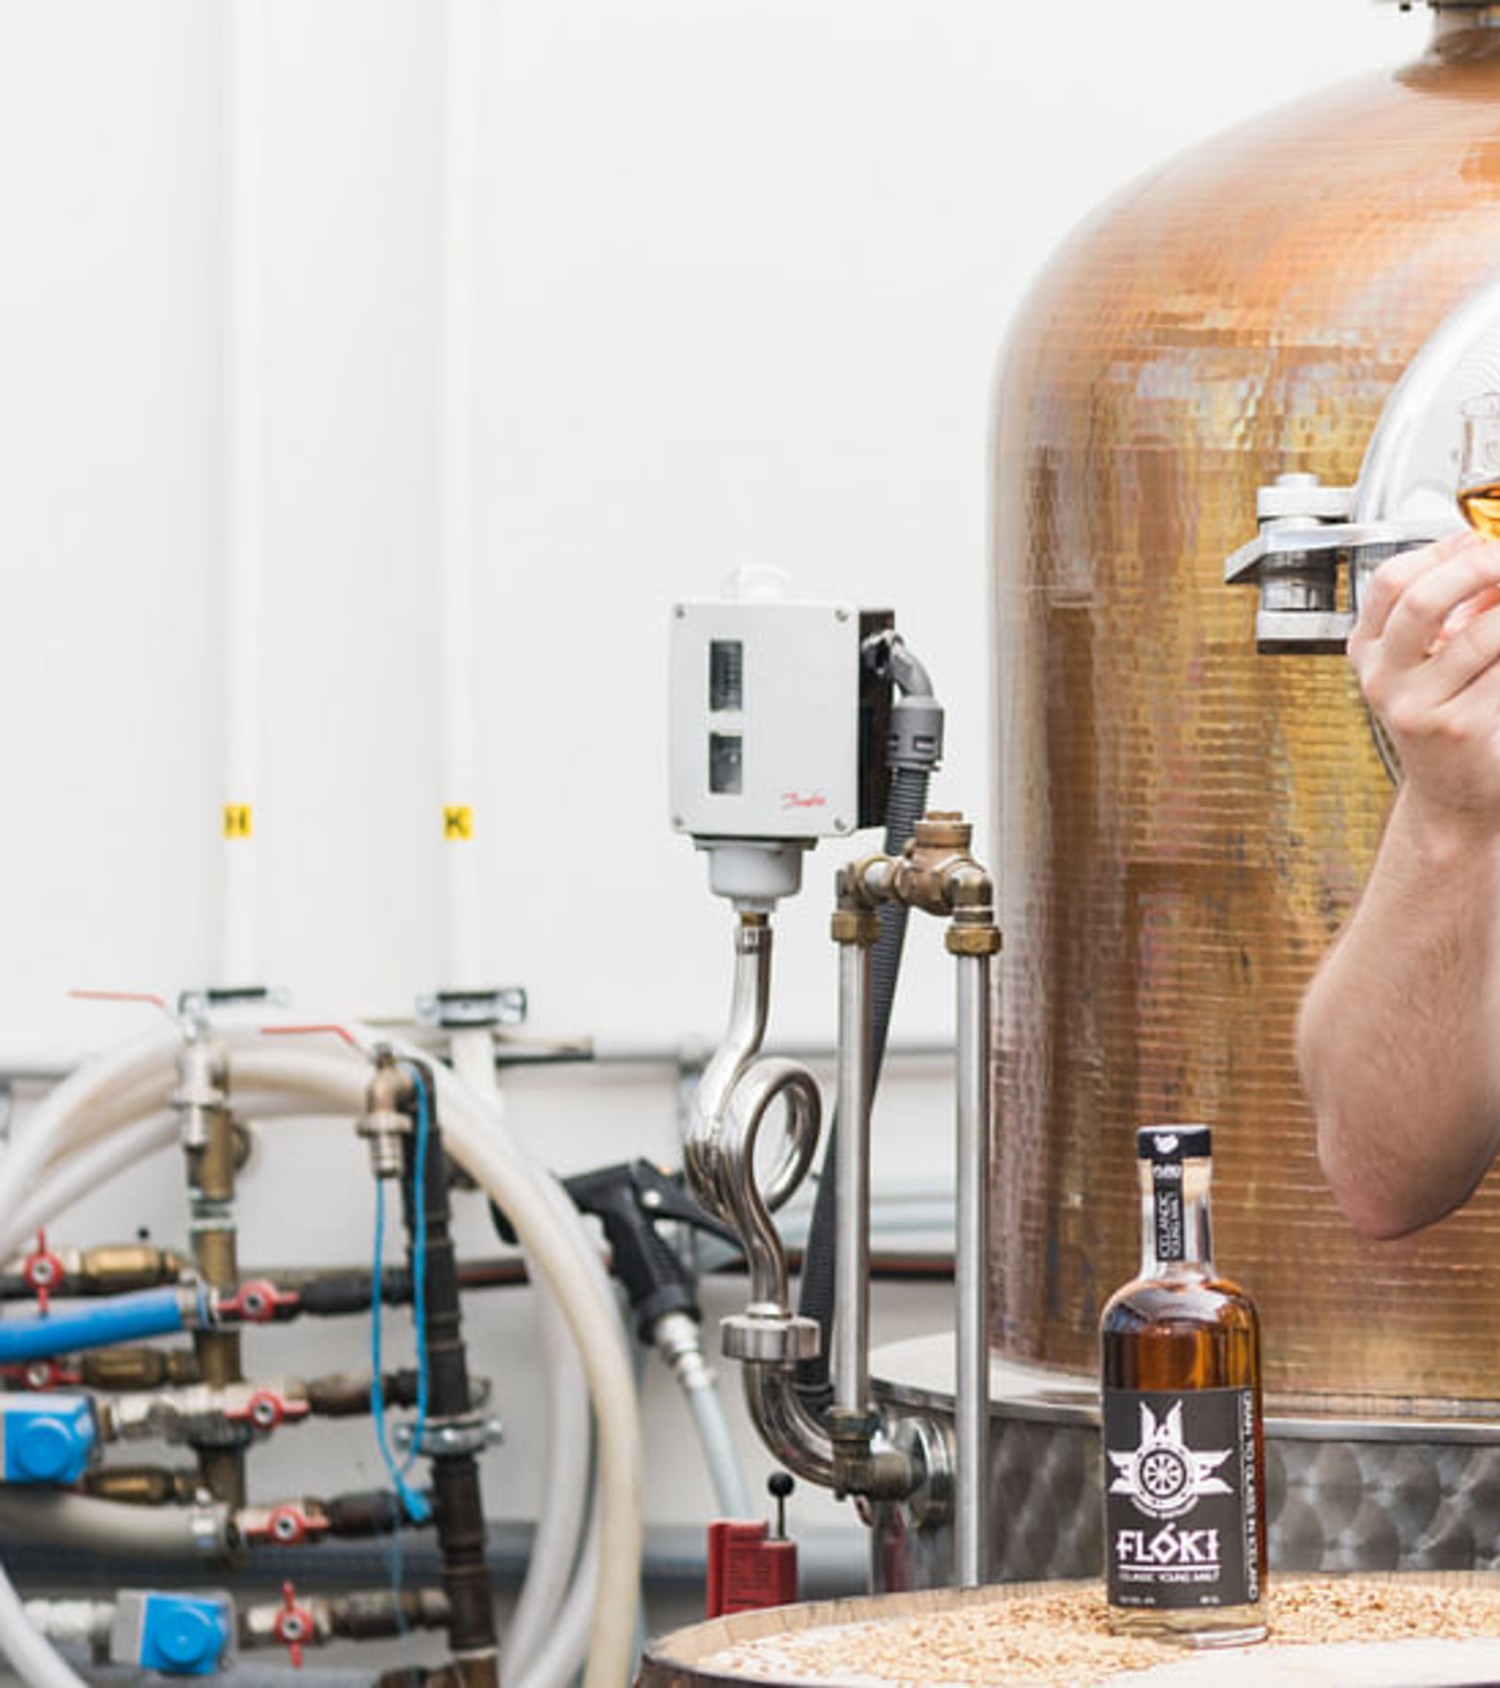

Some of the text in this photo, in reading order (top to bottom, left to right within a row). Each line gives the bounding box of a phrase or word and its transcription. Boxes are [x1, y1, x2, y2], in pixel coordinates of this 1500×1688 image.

[225, 805, 247, 838] H
[445, 805, 470, 839] K
[1116, 1521, 1219, 1564] FLÓKI
